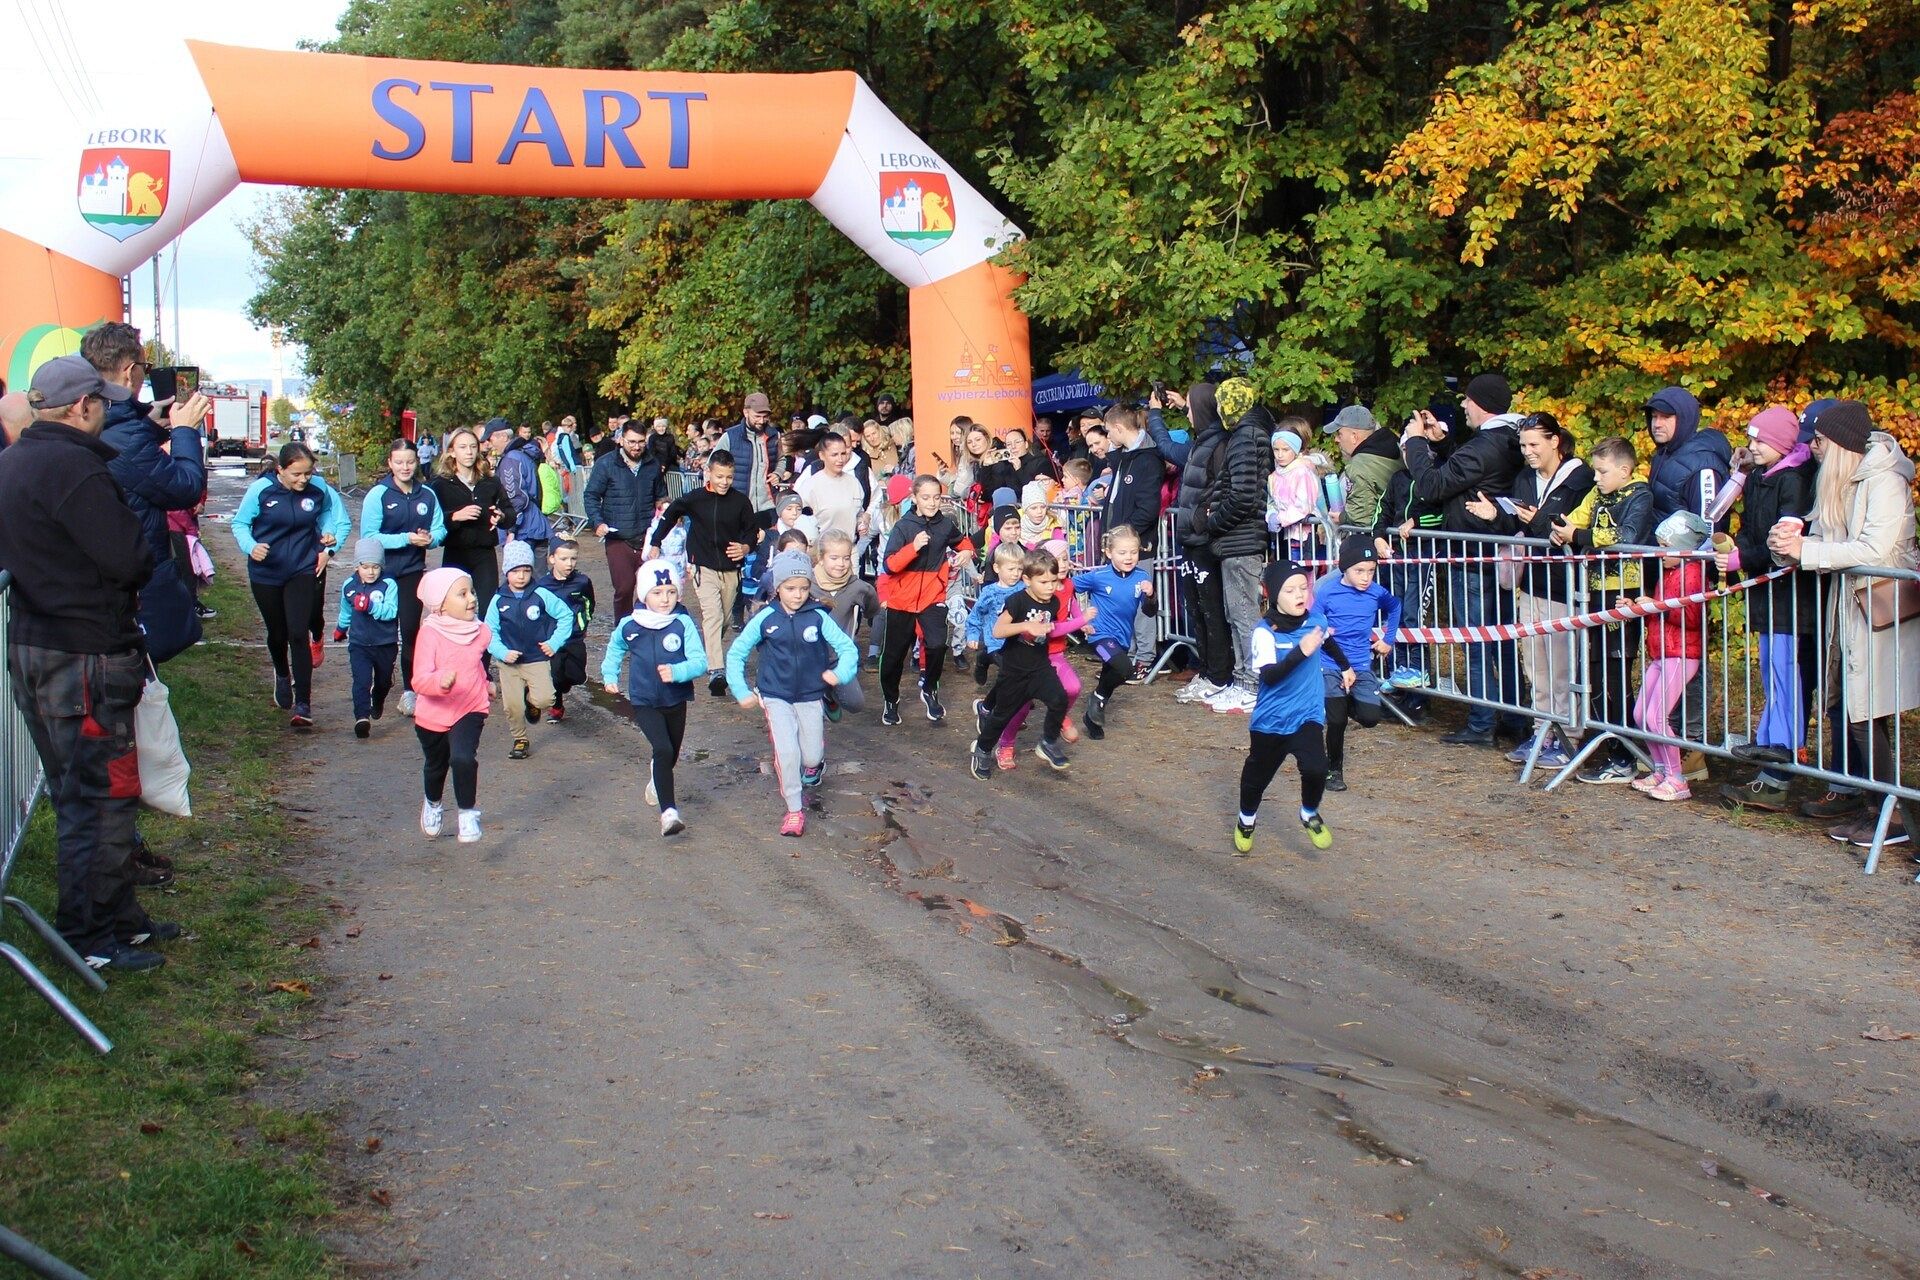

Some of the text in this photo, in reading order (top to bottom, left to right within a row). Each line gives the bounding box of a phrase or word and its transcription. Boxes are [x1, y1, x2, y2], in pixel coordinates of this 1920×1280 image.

[370, 78, 708, 169] START
[87, 128, 167, 146] LĘBORK
[880, 153, 941, 169] LĘBORK
[1035, 386, 1065, 404] CENTRUM
[1065, 382, 1089, 399] SPORTU
[654, 569, 672, 586] M
